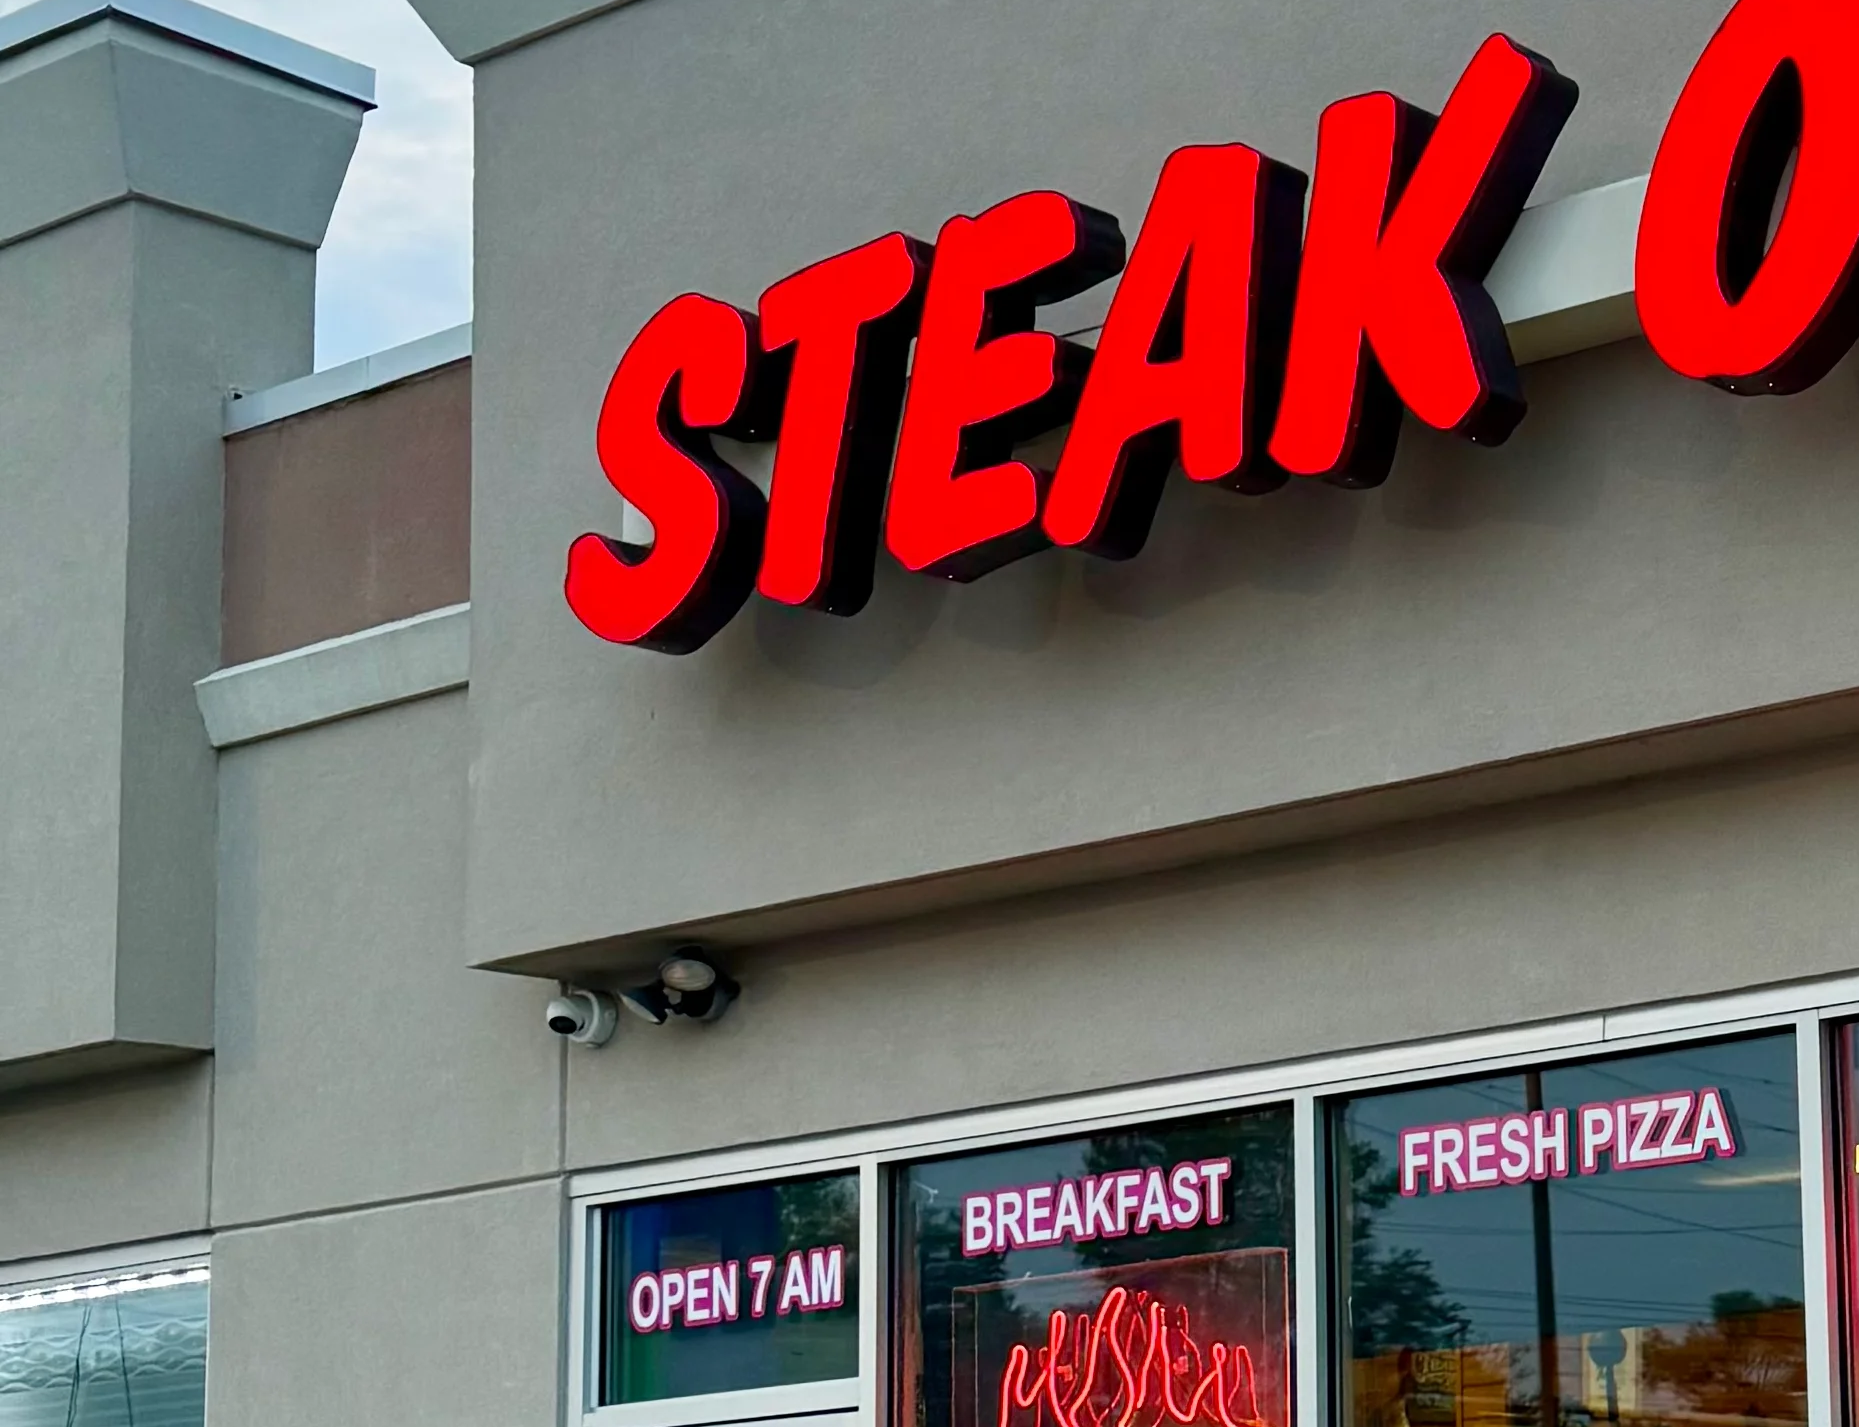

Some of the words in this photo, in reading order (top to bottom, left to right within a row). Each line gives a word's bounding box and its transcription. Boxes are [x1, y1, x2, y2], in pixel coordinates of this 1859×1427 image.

[564, 32, 1576, 652] STEAK
[1403, 1111, 1567, 1191] FRESH
[1583, 1092, 1731, 1169] PIZZA
[964, 1160, 1230, 1253] BREAKFAST
[632, 1263, 737, 1331] OPEN
[751, 1259, 771, 1317] 7
[780, 1248, 842, 1309] AM
